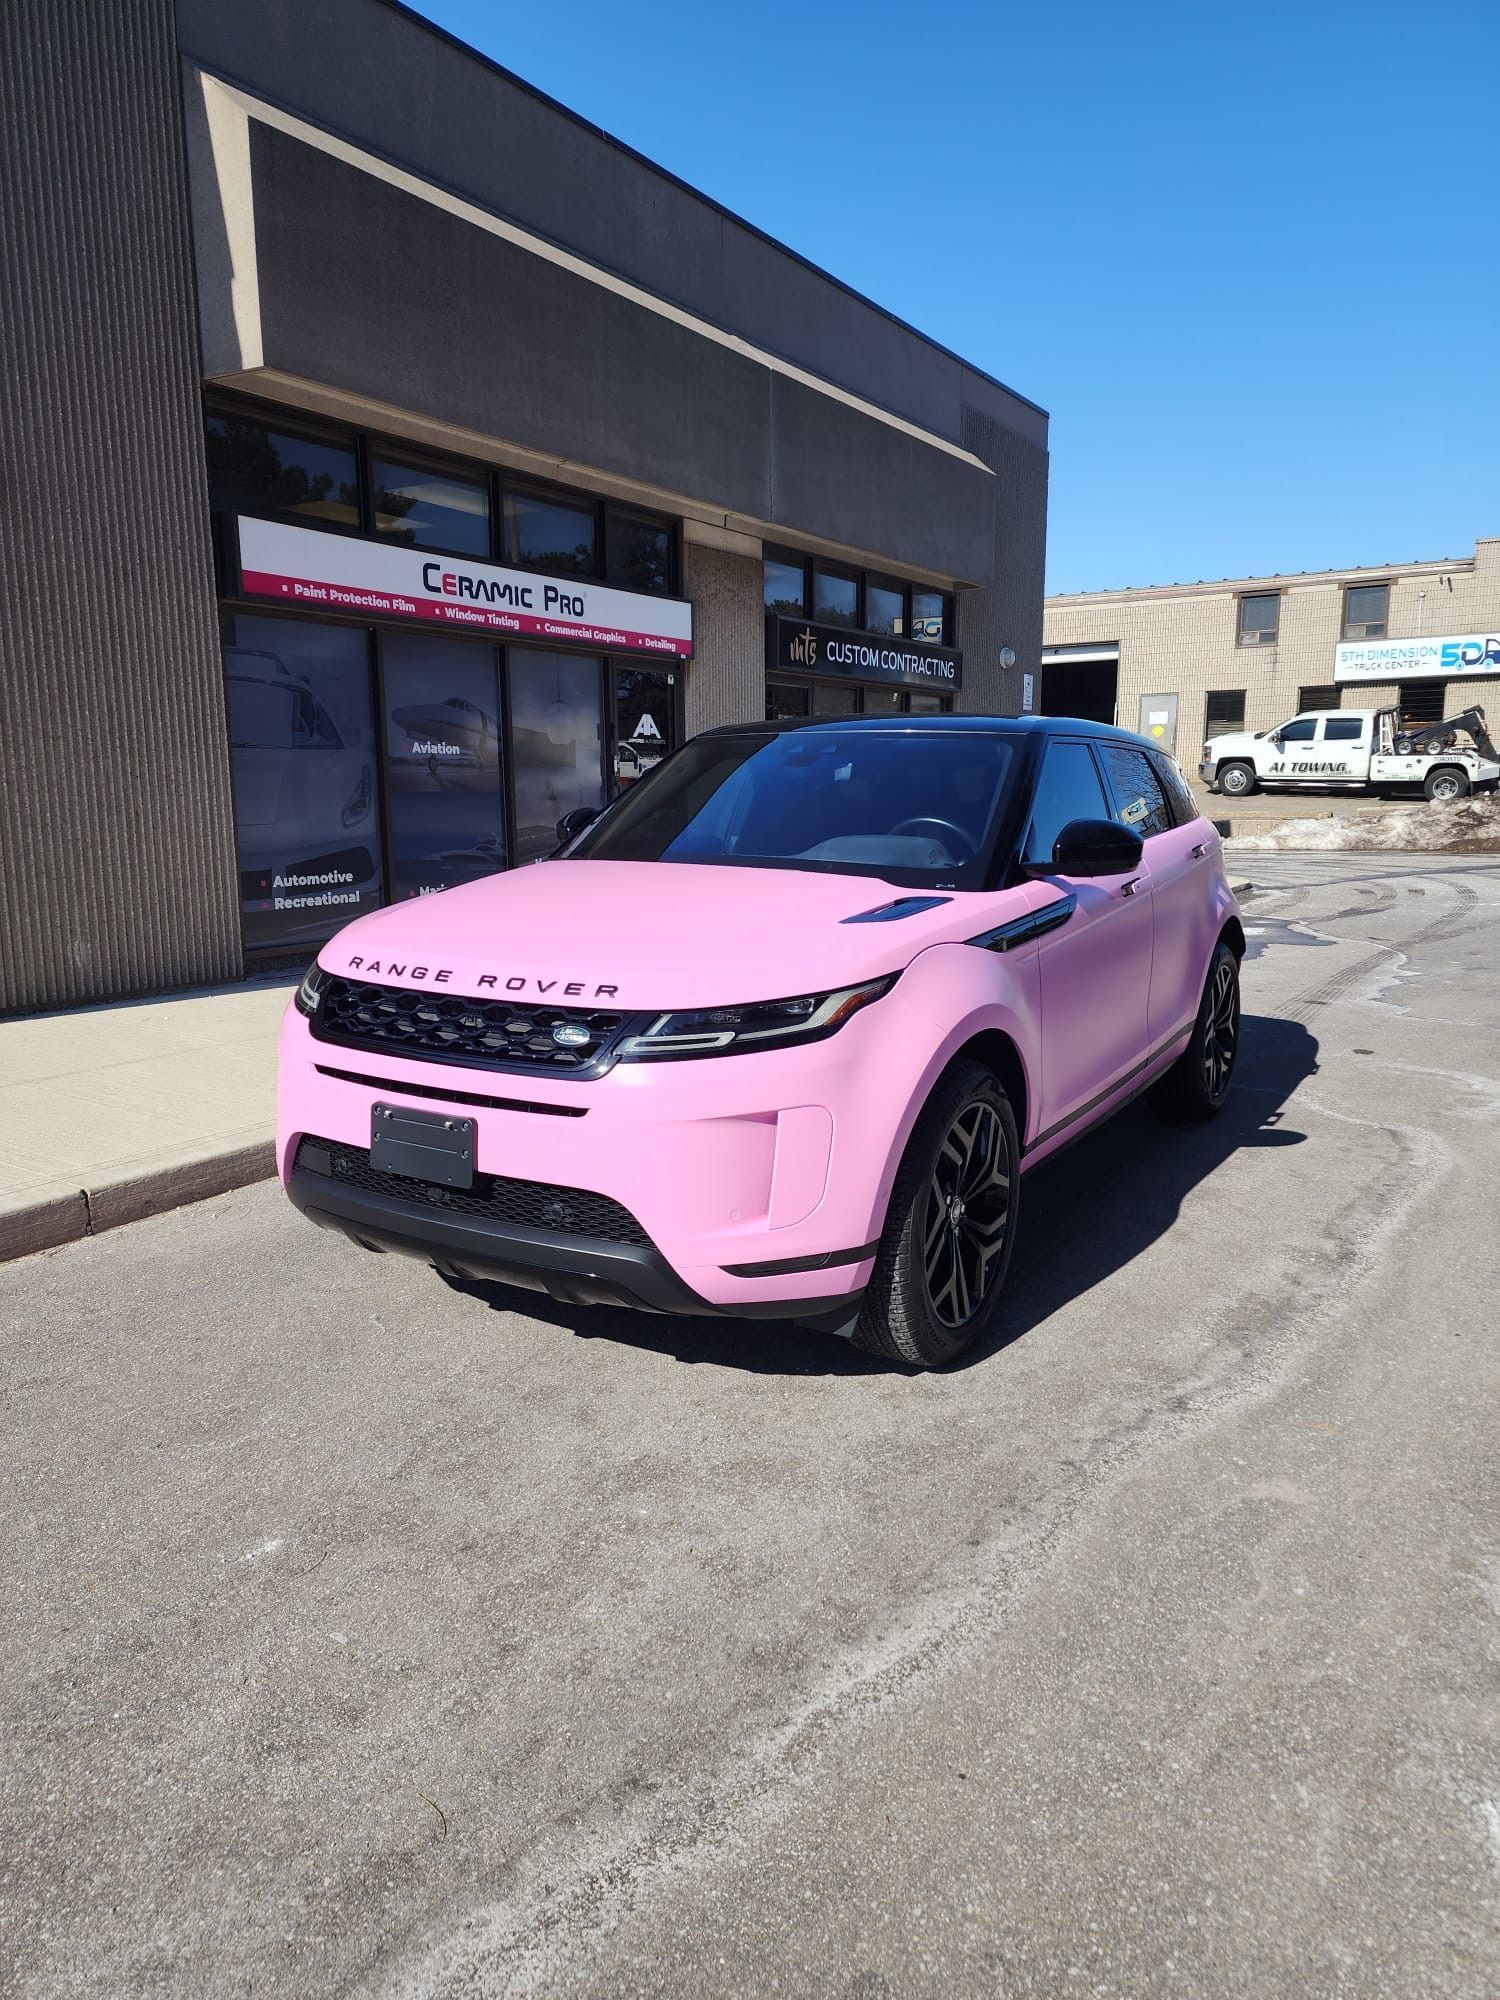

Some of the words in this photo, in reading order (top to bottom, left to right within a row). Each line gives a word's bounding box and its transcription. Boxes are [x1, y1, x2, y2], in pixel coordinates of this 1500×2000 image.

[294, 583, 328, 600] Paint
[329, 589, 391, 609] Protection
[392, 598, 416, 613] Film
[444, 607, 486, 623] Window
[486, 613, 520, 630] Tinting
[544, 622, 593, 639] Commercial
[593, 631, 627, 644] Graphics
[645, 637, 677, 652] Detailing
[826, 641, 879, 668] CUSTOM
[881, 650, 955, 679] CONTRACTING
[1341, 650, 1364, 662] 5TH
[1367, 647, 1438, 661] DIMENSION
[1354, 662, 1383, 671] TRUCK
[1384, 660, 1421, 670] CENTER
[412, 741, 460, 755] Aviation
[1291, 762, 1348, 773] TOWING
[272, 869, 354, 888] Automotive
[274, 890, 361, 910] Recreational
[348, 956, 454, 983] RANGE
[477, 975, 619, 999] ROVER
